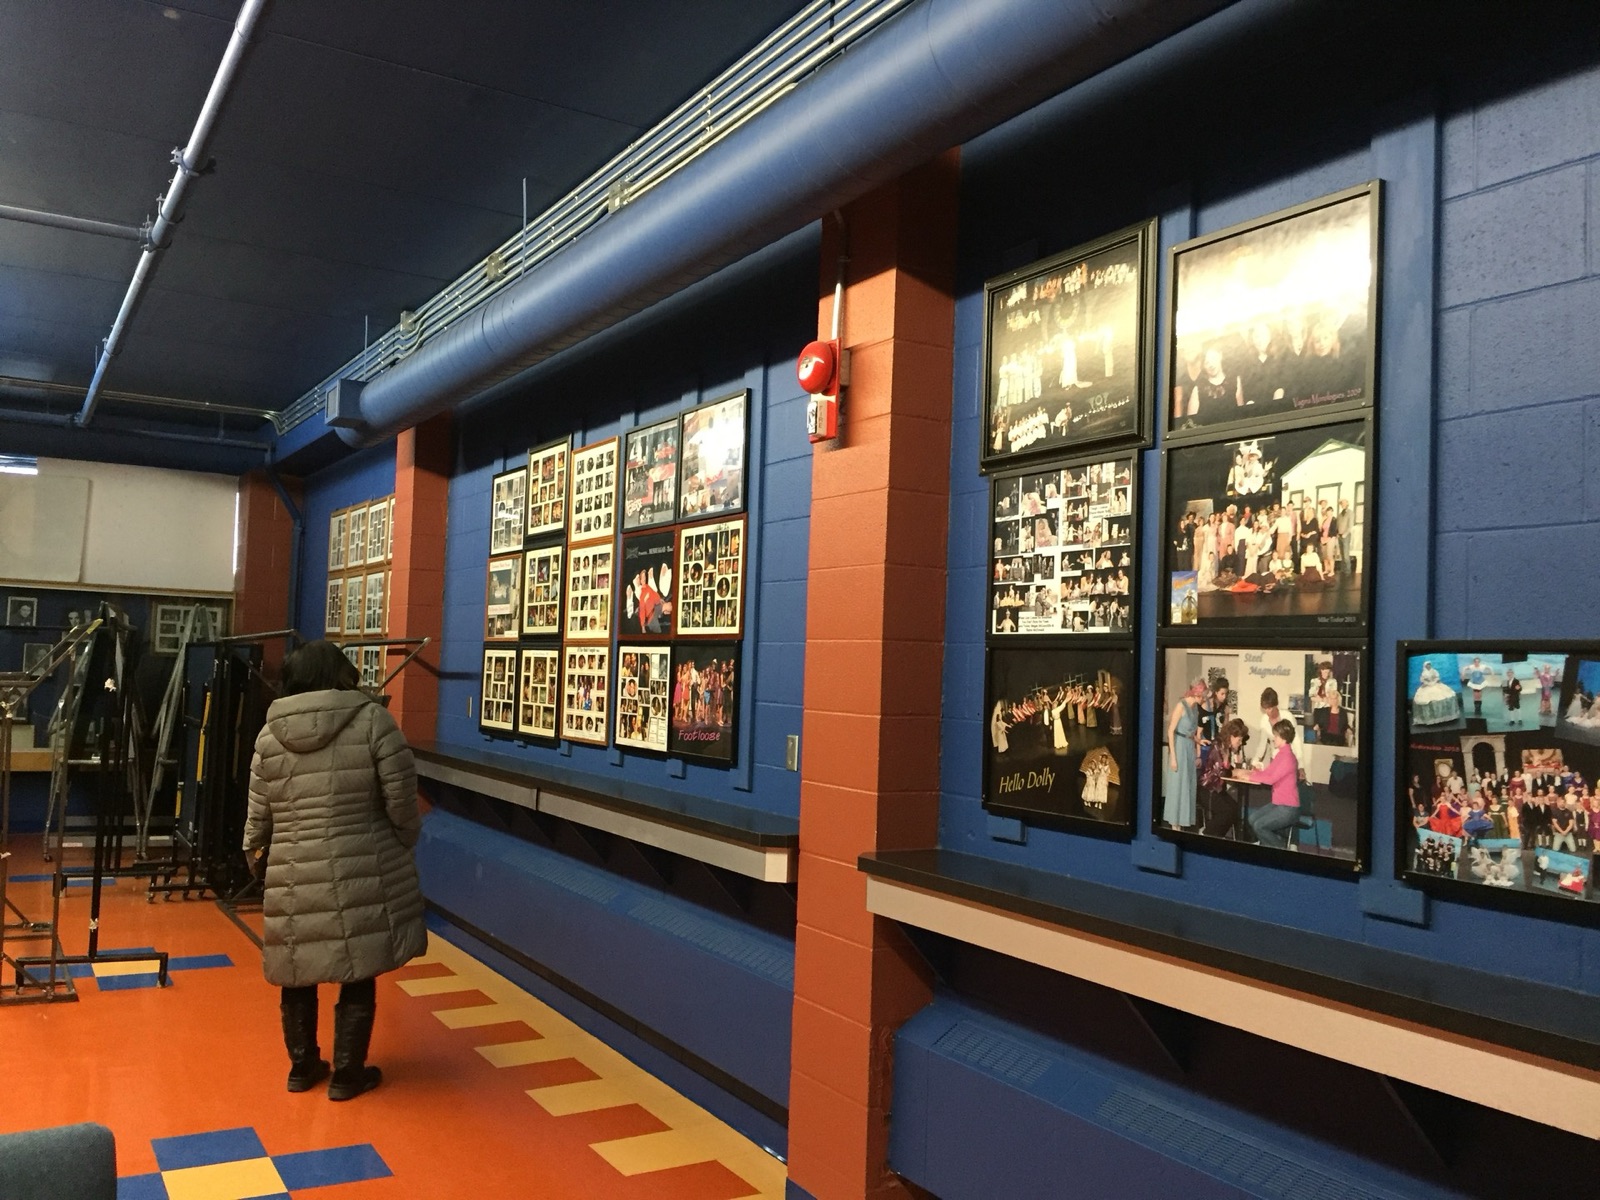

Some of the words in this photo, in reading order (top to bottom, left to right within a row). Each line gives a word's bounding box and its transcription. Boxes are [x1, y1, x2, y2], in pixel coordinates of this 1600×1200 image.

[1248, 664, 1291, 679] Magnolias
[678, 729, 721, 741] Footloose
[999, 772, 1025, 794] Hello
[1026, 766, 1056, 793] Dolly
